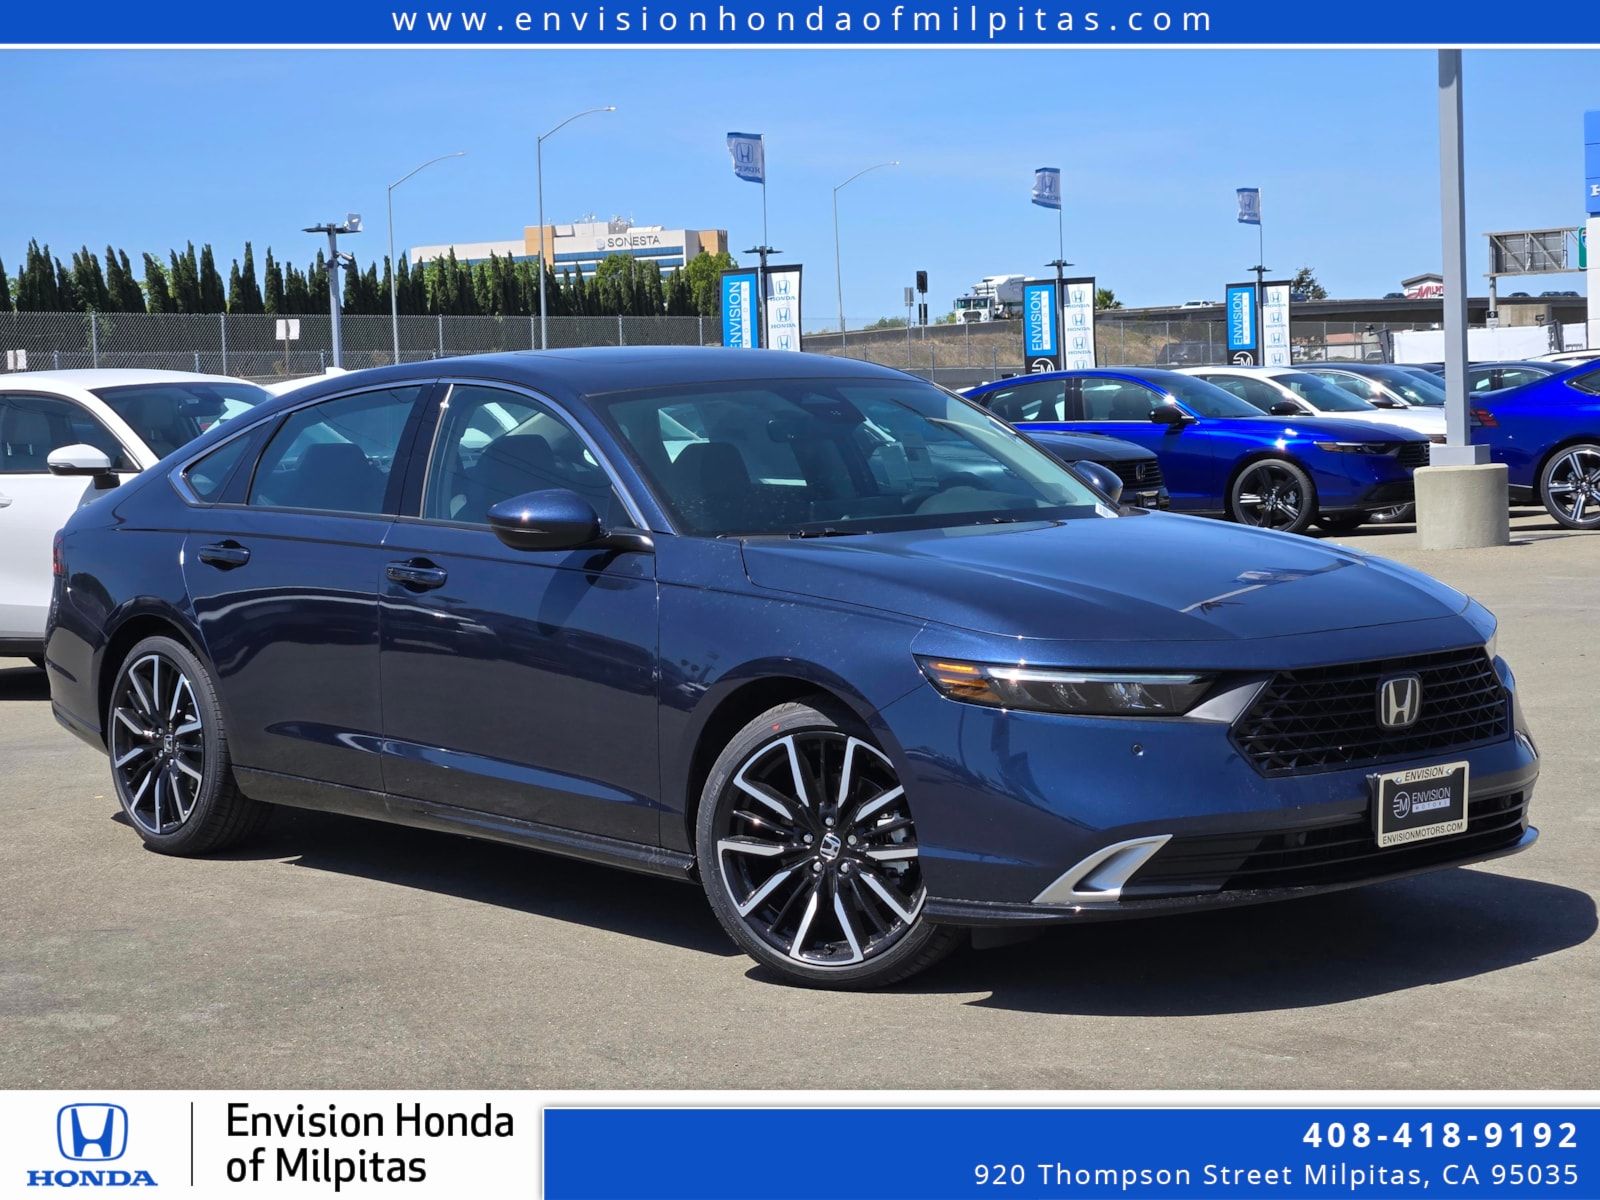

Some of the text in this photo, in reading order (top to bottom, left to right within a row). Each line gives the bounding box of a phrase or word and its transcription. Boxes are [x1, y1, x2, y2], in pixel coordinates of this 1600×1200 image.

[607, 235, 661, 248] SONESTA
[1031, 291, 1042, 350] ENVISION
[1233, 292, 1242, 345] ENVISION
[1405, 766, 1444, 781] ENVISION
[1412, 786, 1451, 804] ENVISION
[1382, 821, 1464, 845] ENVISIONMOTORS.COM
